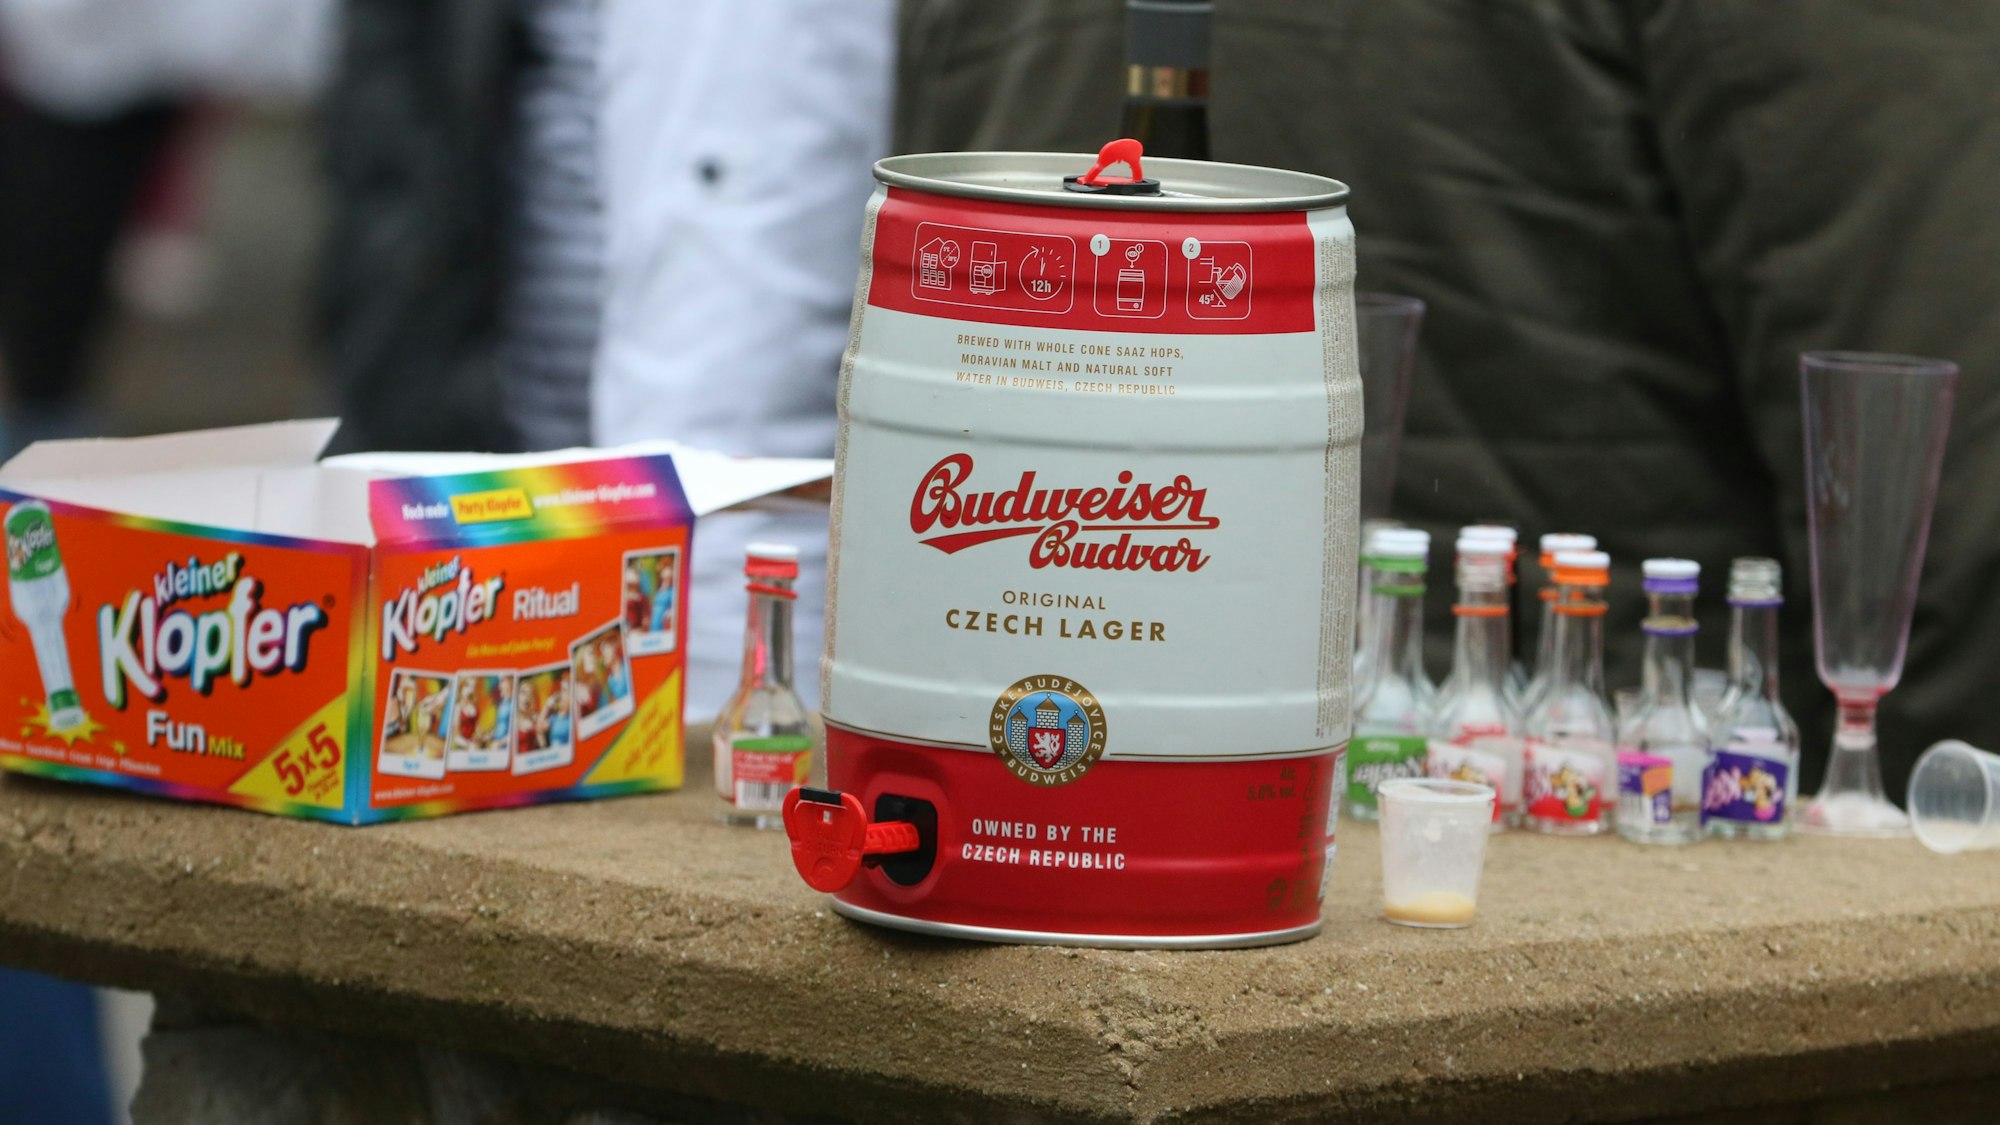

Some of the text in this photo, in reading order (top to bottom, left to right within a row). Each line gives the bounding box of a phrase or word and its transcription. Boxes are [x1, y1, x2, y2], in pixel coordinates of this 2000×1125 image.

[1098, 240, 1102, 249] 1
[1188, 243, 1195, 253] 2
[1031, 280, 1052, 293] 12h
[957, 334, 1184, 360] BREWED WITH WHOLE CONE SAAZ HOPS,
[961, 353, 1173, 377] MORAVIAN MALT AND NATURAL SOFT
[956, 371, 1176, 395] WATER IN BUDWEIS, CZECH REPUBLIC
[458, 496, 522, 517] Party Klopfer
[910, 452, 1220, 534] Budweiser
[1029, 519, 1211, 573] Budvar
[154, 550, 242, 606] kleiner
[417, 555, 461, 595] kleiner
[513, 582, 580, 622] Ritual
[1002, 590, 1106, 610] ORIGINAL
[382, 567, 504, 662] Klopfer
[946, 609, 1166, 642] CZECH LAGER
[97, 576, 325, 709] Klopfer
[146, 710, 246, 760] Fun Mix
[272, 723, 341, 797] 5x5
[1007, 759, 1086, 784] BUDWEIS
[972, 818, 1116, 843] OWNED BY THE
[962, 843, 1125, 870] CZECH REPUBLIC
